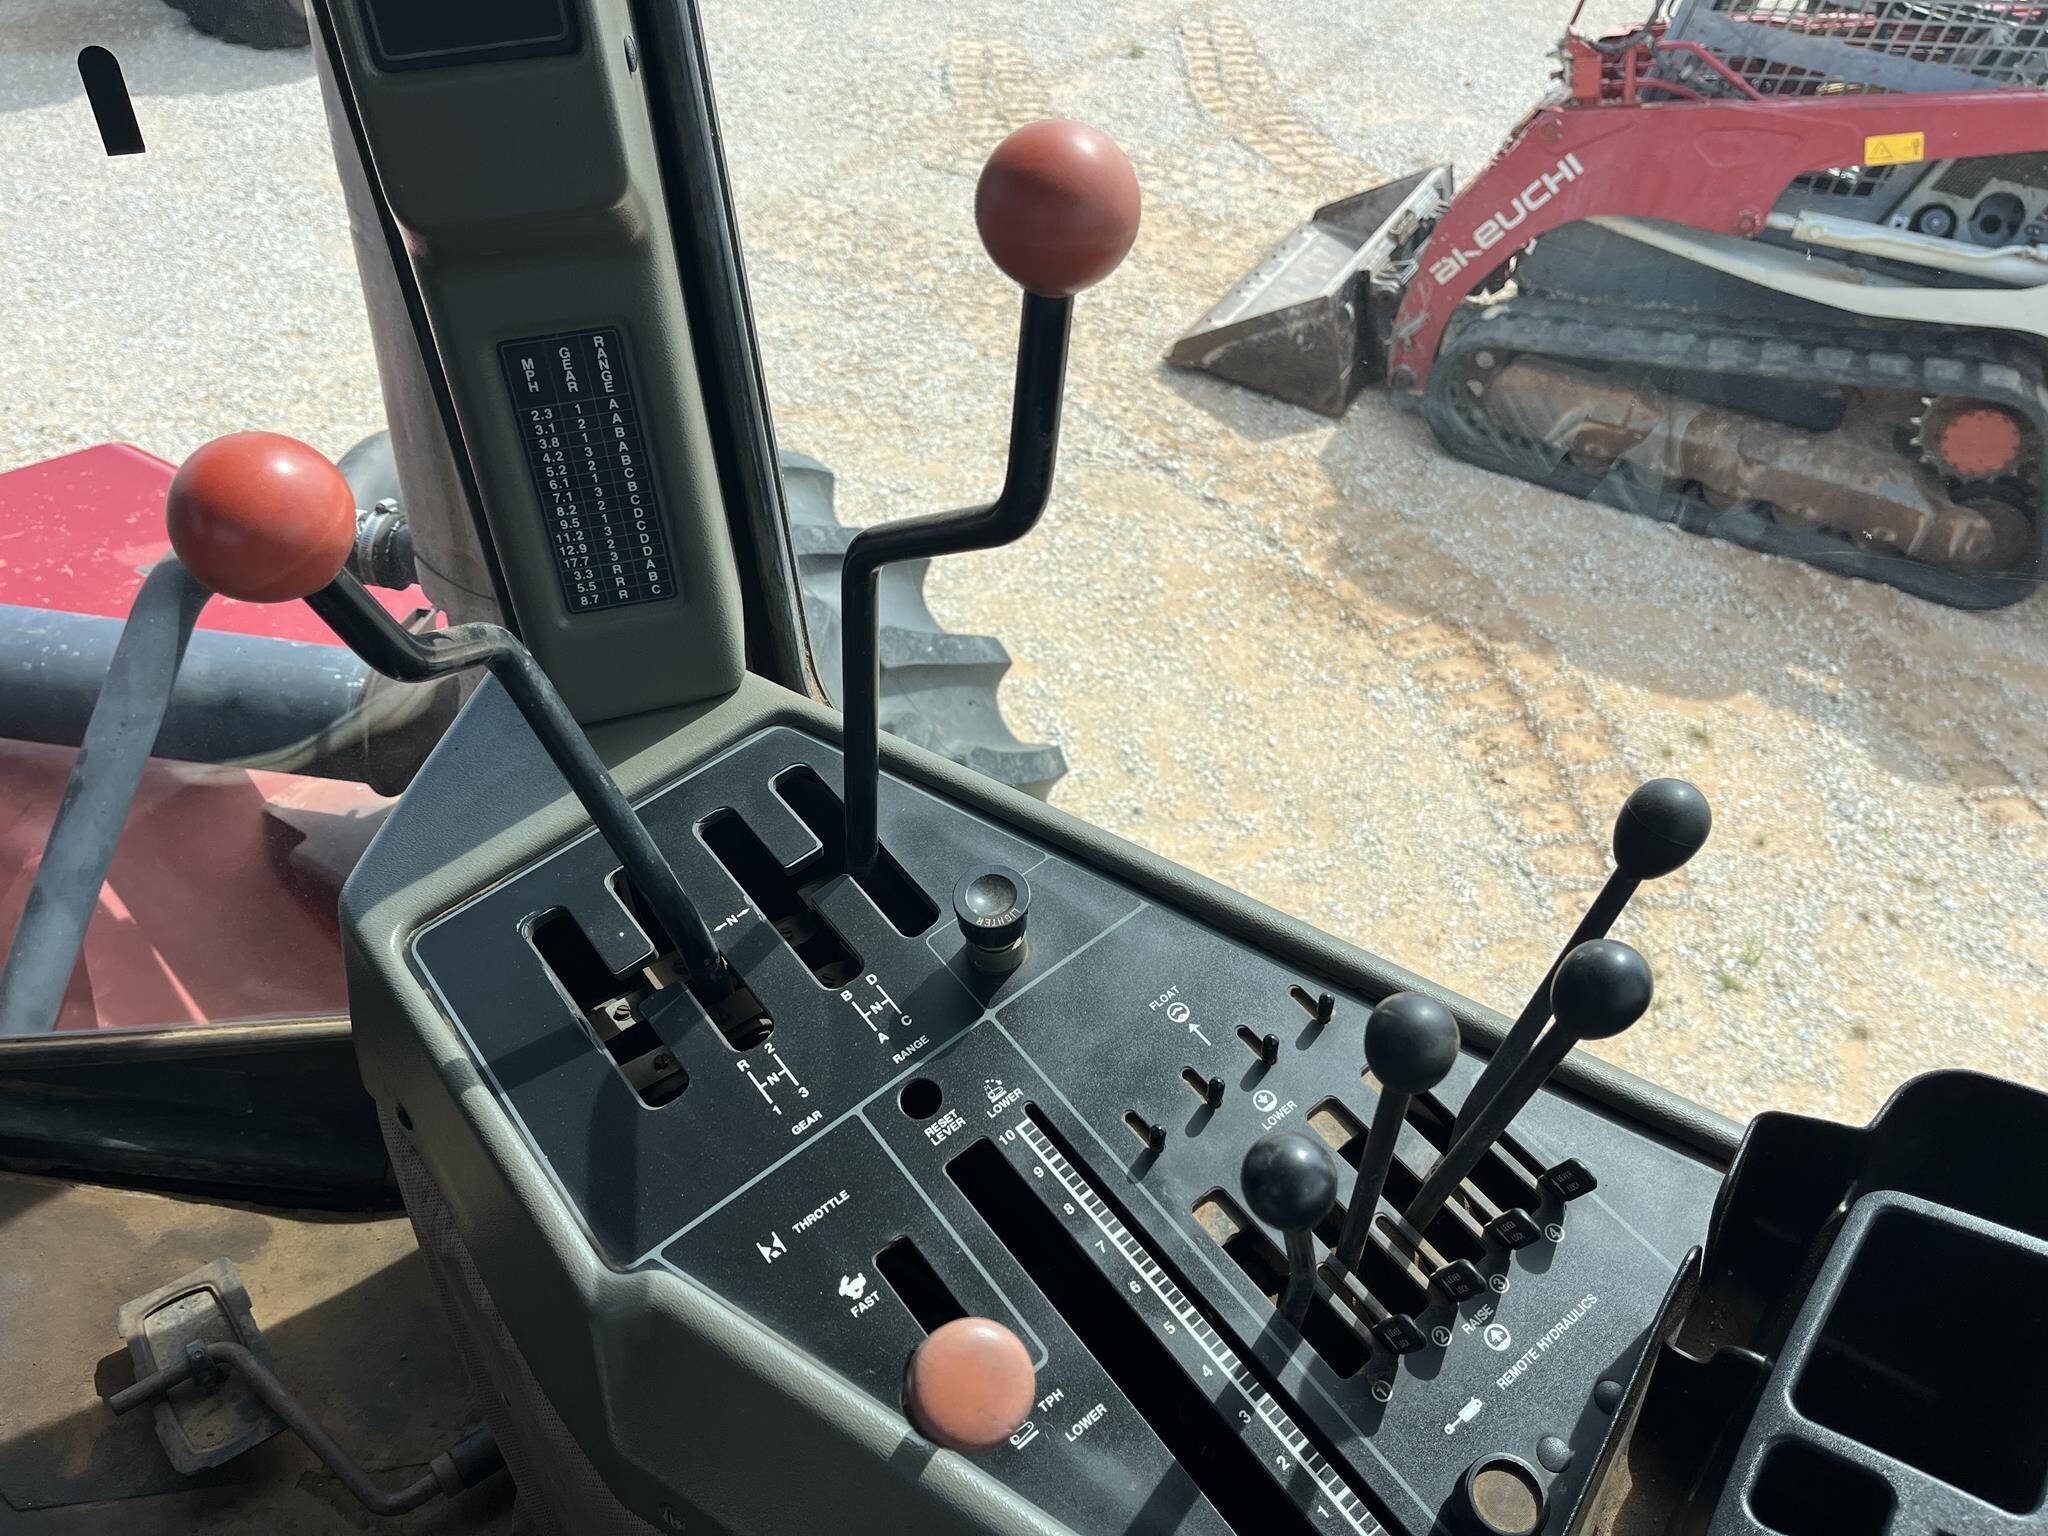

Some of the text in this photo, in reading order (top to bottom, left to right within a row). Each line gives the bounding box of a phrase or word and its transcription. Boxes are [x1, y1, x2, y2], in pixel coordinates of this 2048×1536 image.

[521, 358, 539, 392] MPH
[559, 347, 578, 392] GEAR
[593, 336, 614, 392] RANGE
[531, 399, 619, 421] 2.3 1 A
[534, 413, 622, 435] 3.1 2 A
[538, 427, 625, 449] 3.8 1 B
[542, 441, 629, 464] 4.2 3 A
[546, 455, 632, 477] 5.2 2 B
[550, 468, 635, 490] 6.1 1 C
[553, 481, 638, 504] 7.1 3 B
[556, 495, 641, 517] 8.2 2 C
[560, 508, 644, 530] 9.5 1 D
[556, 521, 647, 543] 11.2 3 C
[560, 534, 650, 556] 12.9 2 D
[564, 546, 653, 569] 17.7 3 D
[573, 559, 656, 581] 3.3 R A
[577, 572, 659, 593] 5.5 R B
[581, 585, 661, 606] 8.7 R C
[725, 914, 738, 926] N
[976, 907, 1021, 927] LIGHTER
[865, 974, 878, 985] D
[841, 990, 853, 1001] B
[1149, 985, 1181, 1012] FLOAT
[870, 1001, 883, 1015] N
[901, 1015, 913, 1026] C
[764, 1042, 775, 1055] 2
[878, 1033, 890, 1044] A
[892, 1034, 930, 1065] RANGE
[736, 1059, 750, 1073] R
[767, 1072, 780, 1085] N
[798, 1087, 809, 1098] 3
[986, 1087, 1024, 1119] LOWER
[772, 1104, 782, 1116] 1
[1261, 1100, 1298, 1131] LOWER
[791, 1110, 823, 1136] GEAR
[924, 1109, 958, 1139] RESET
[930, 1117, 966, 1147] LEVER
[998, 1129, 1016, 1146] 10
[1033, 1166, 1045, 1178] 9
[791, 1189, 851, 1235] THROTTLE
[1063, 1203, 1075, 1215] 8
[1095, 1239, 1106, 1253] 7
[1129, 1280, 1142, 1294] 6
[1492, 1276, 1507, 1291] 3
[850, 1290, 881, 1319] FAST
[1164, 1320, 1176, 1335] 5
[1461, 1304, 1494, 1335] RAISE
[1434, 1328, 1450, 1344] 2
[1496, 1293, 1598, 1390] REMOTE HYDRAULICS
[1201, 1364, 1213, 1377] 4
[1037, 1388, 1065, 1413] TPH
[1065, 1403, 1108, 1443] LOWER
[1238, 1410, 1251, 1424] 3
[1276, 1455, 1290, 1471] 2
[1317, 1505, 1330, 1518] 1
